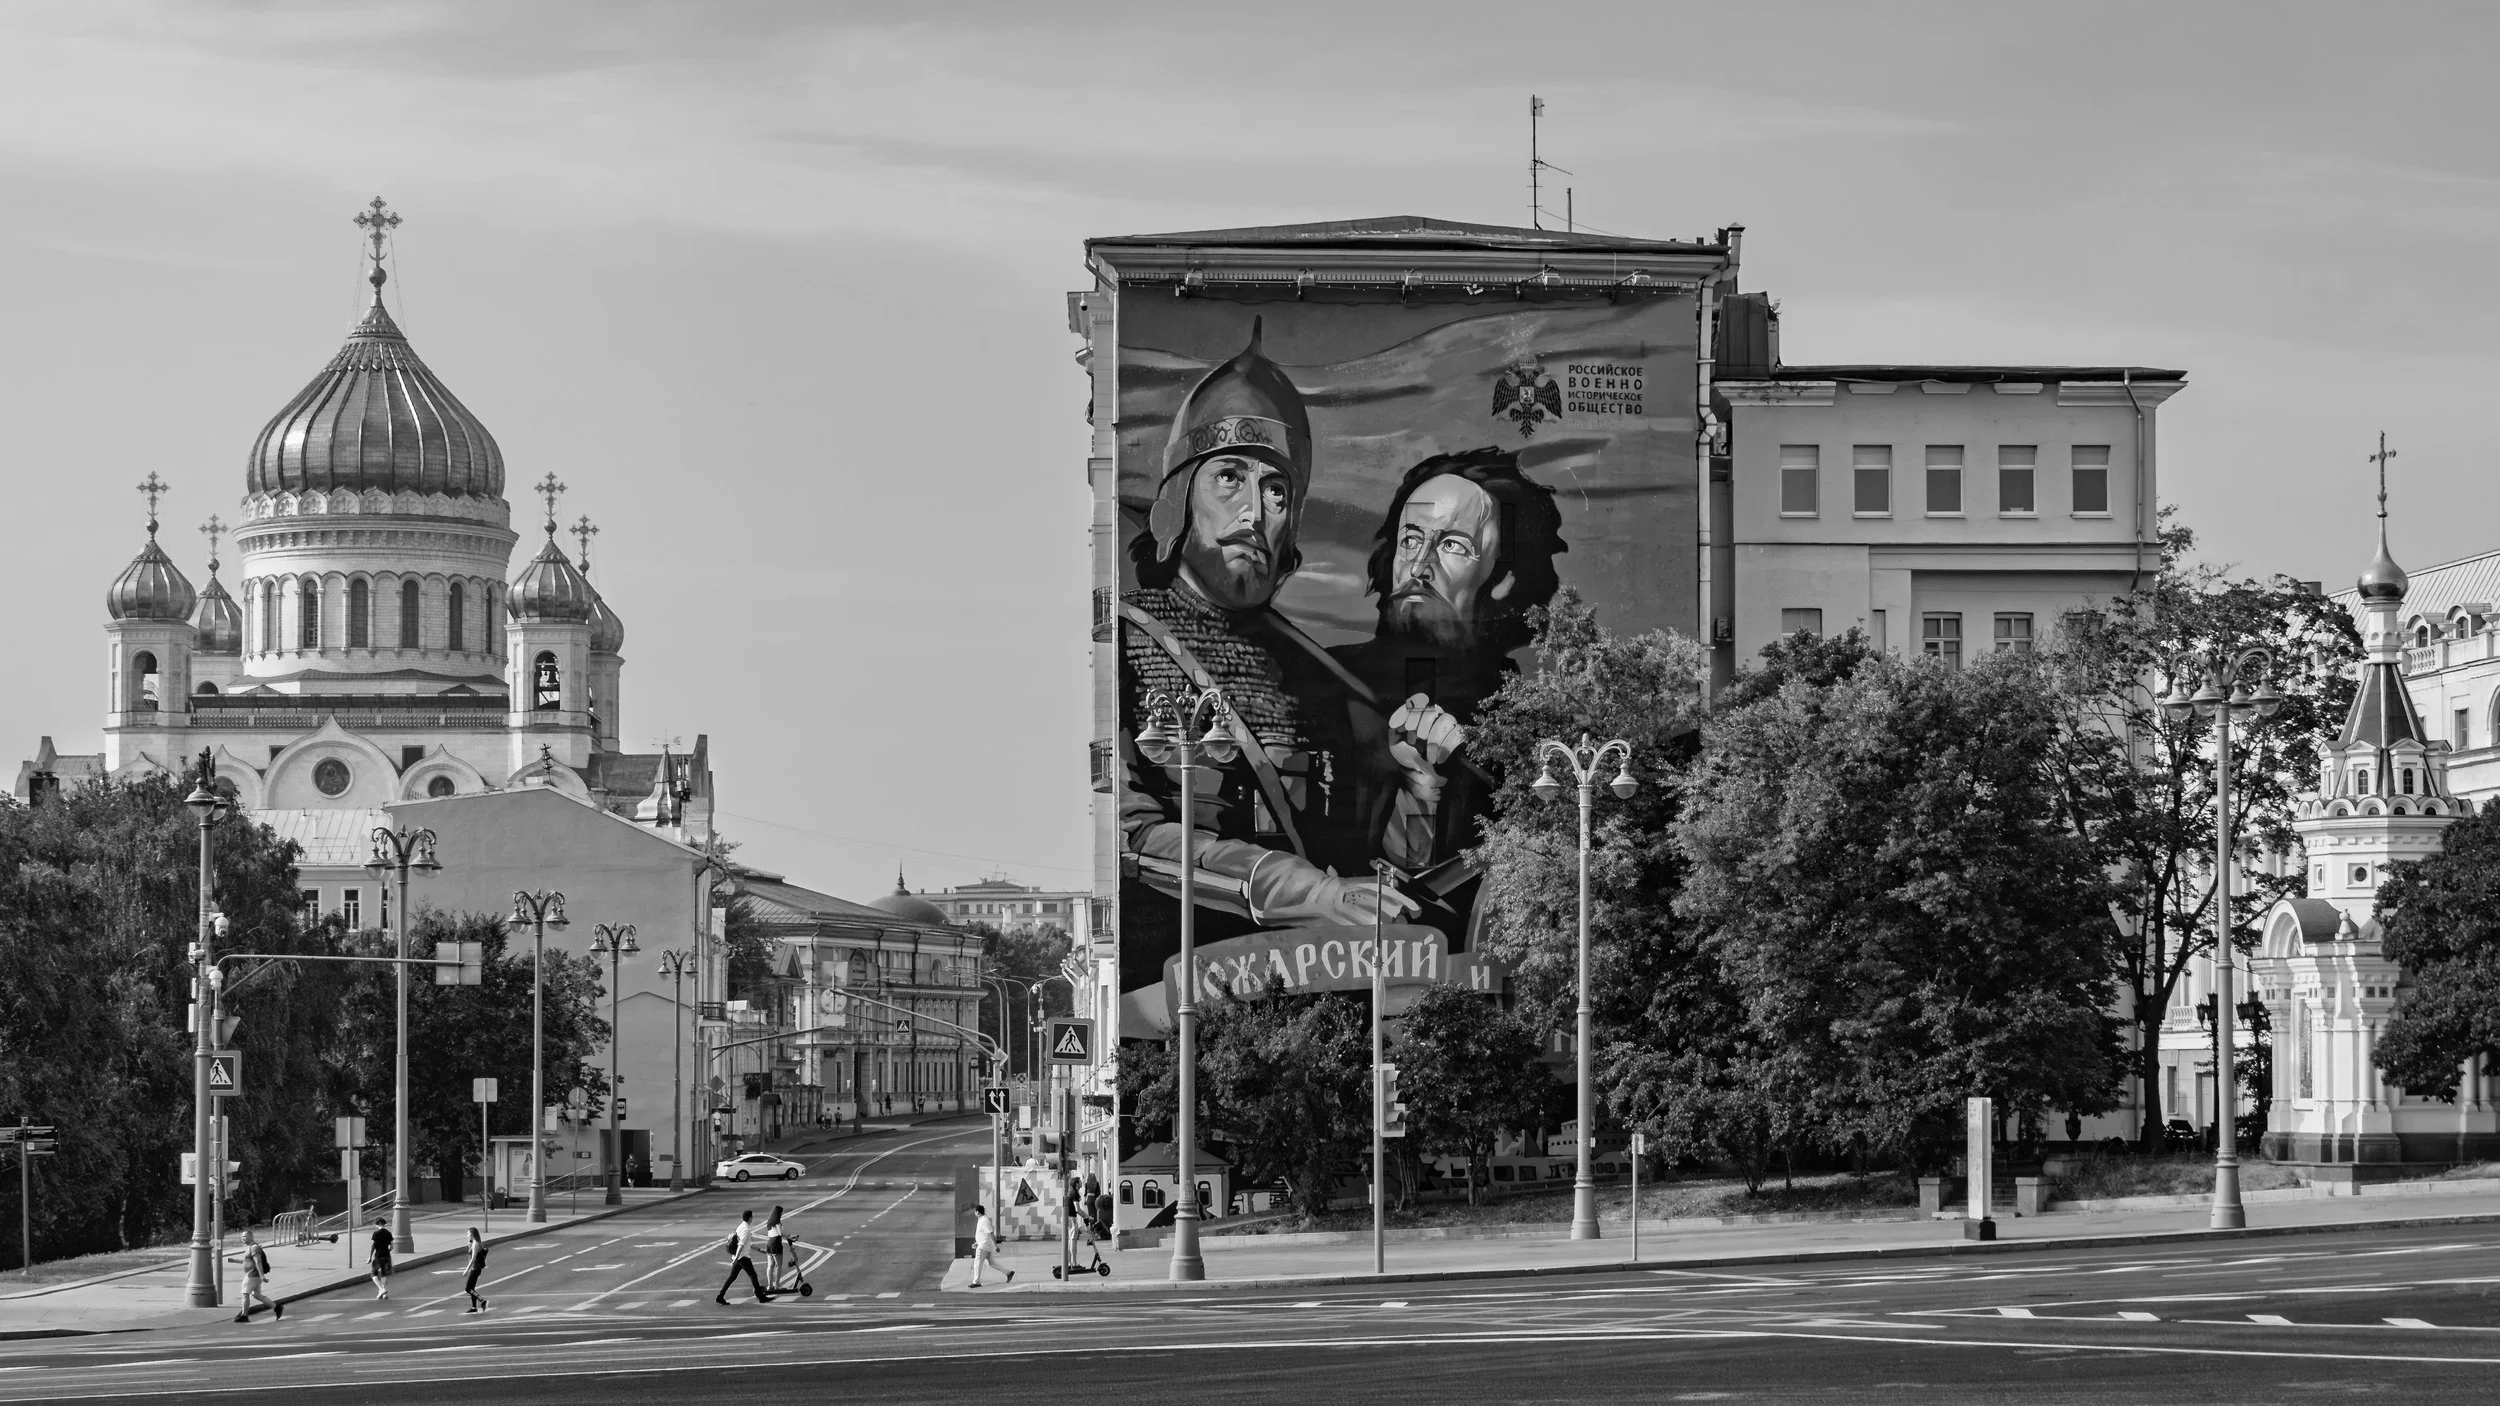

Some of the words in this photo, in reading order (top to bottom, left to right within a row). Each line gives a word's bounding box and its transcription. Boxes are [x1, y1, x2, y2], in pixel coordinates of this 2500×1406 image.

[1568, 364, 1643, 376] РОССИЙСКОЕ
[1568, 377, 1643, 390] ВОЕННО
[1568, 391, 1643, 402] ИСТОРИЧЕСКОЕ
[1568, 402, 1643, 415] ОБЩЕСТВО
